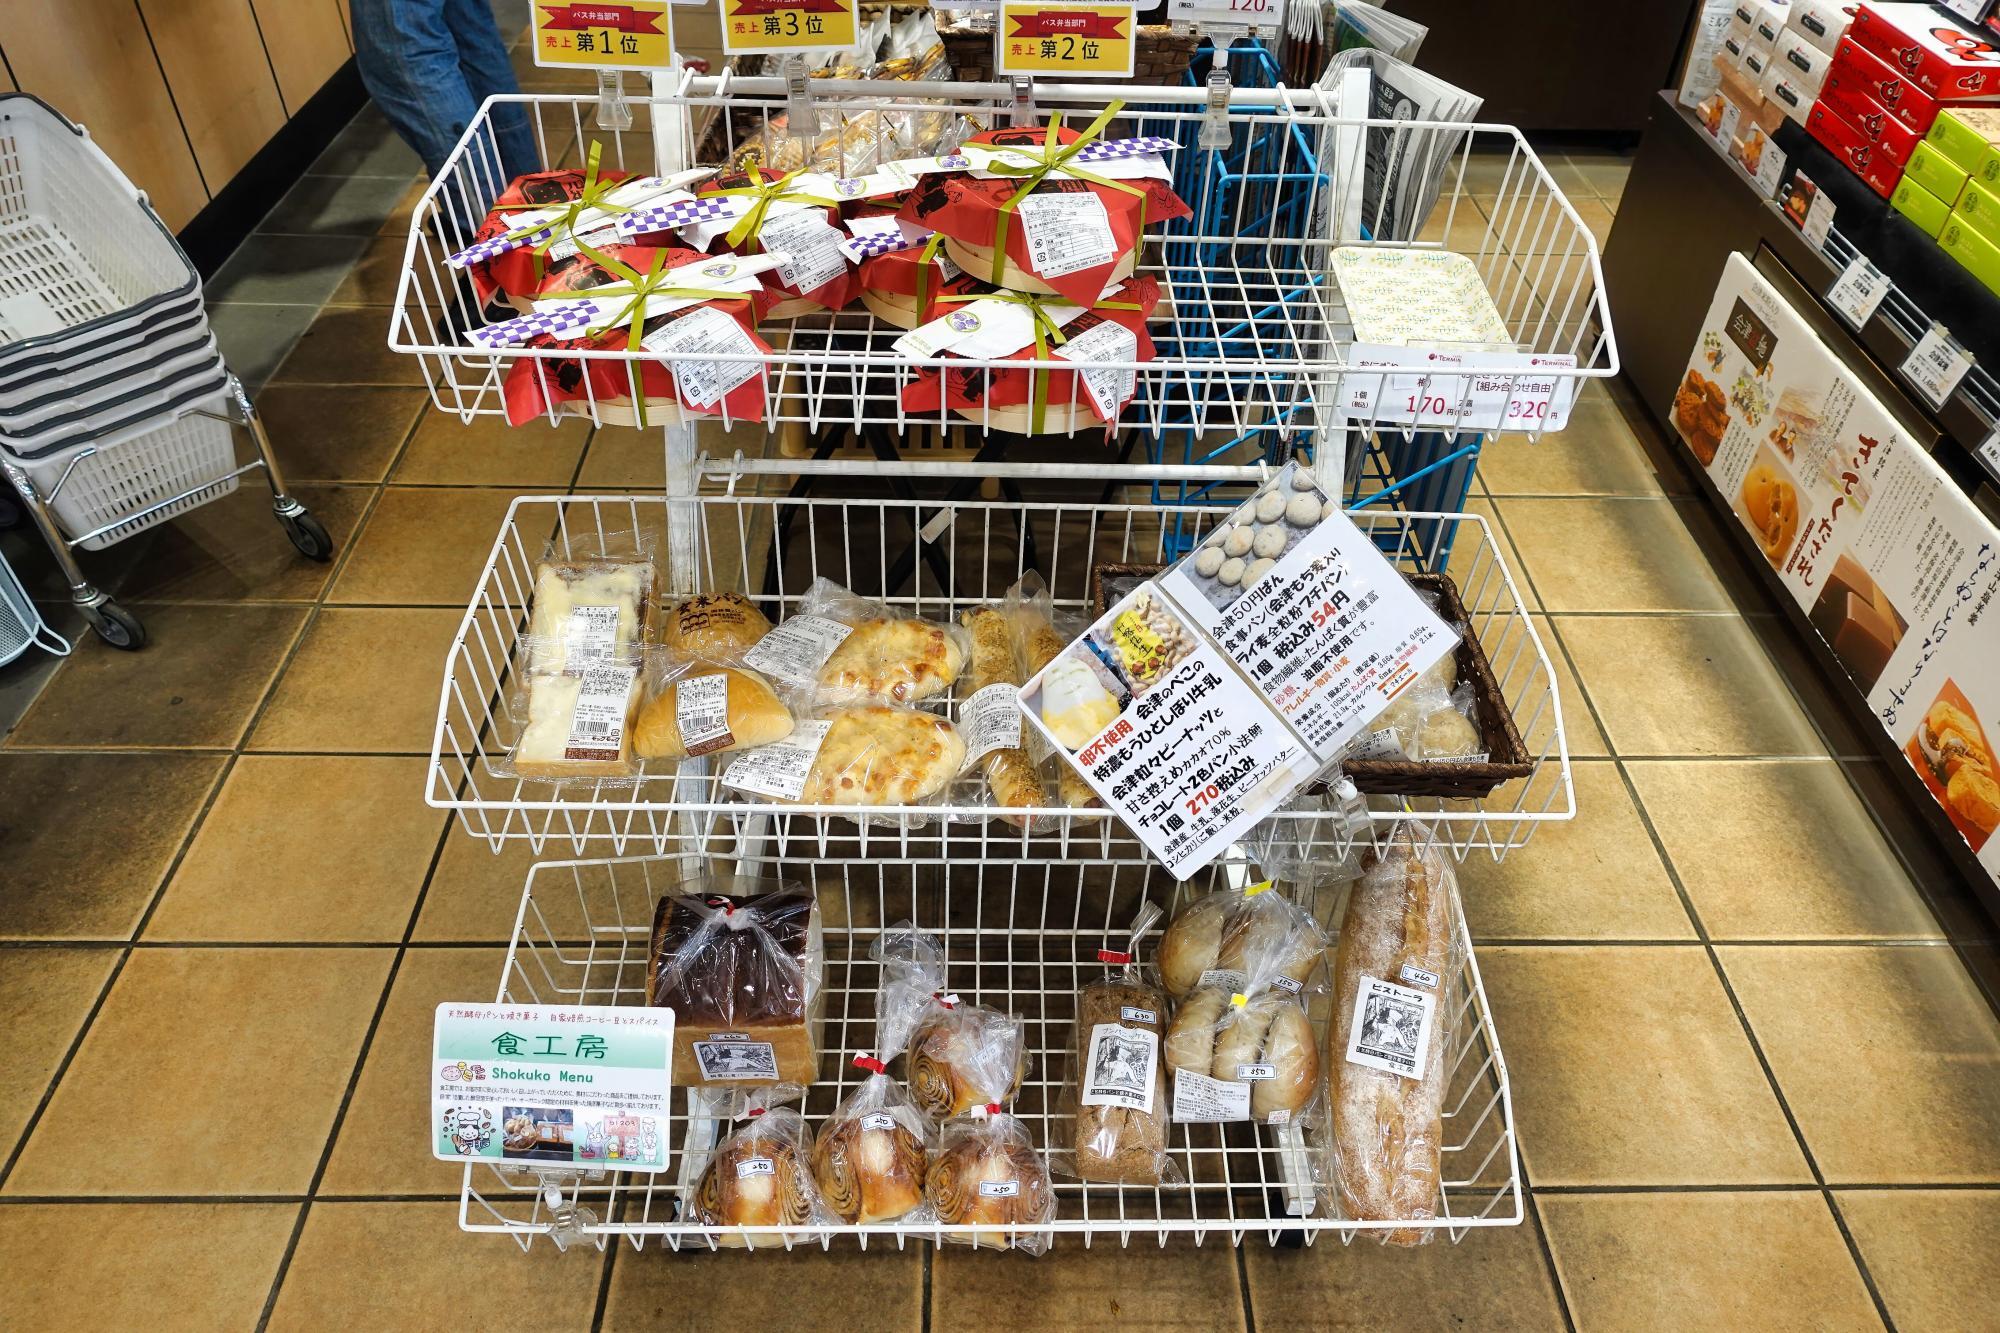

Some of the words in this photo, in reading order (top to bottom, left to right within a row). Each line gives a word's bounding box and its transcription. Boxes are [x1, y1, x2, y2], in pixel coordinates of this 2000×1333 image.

[573, 10, 620, 21] バス弁当部門
[734, 22, 759, 34] 売上
[764, 12, 823, 36] 第3位
[1042, 18, 1087, 28] バス弁当部門
[546, 36, 572, 48] 売上
[577, 33, 639, 54] 第1位
[1011, 44, 1036, 55] 売上
[1040, 36, 1100, 60] 第2位
[1213, 575, 1284, 640] 会津50円ぱん
[1250, 658, 1274, 681] 1個
[1111, 707, 1224, 803] 会津粒々ピーナッツと
[1159, 813, 1185, 837] 1個
[448, 1009, 539, 1021] 天然酵母パンと焼き菓子
[491, 1031, 608, 1059] 食工房
[492, 1067, 551, 1082] Shokuko
[559, 1071, 593, 1083] Menu
